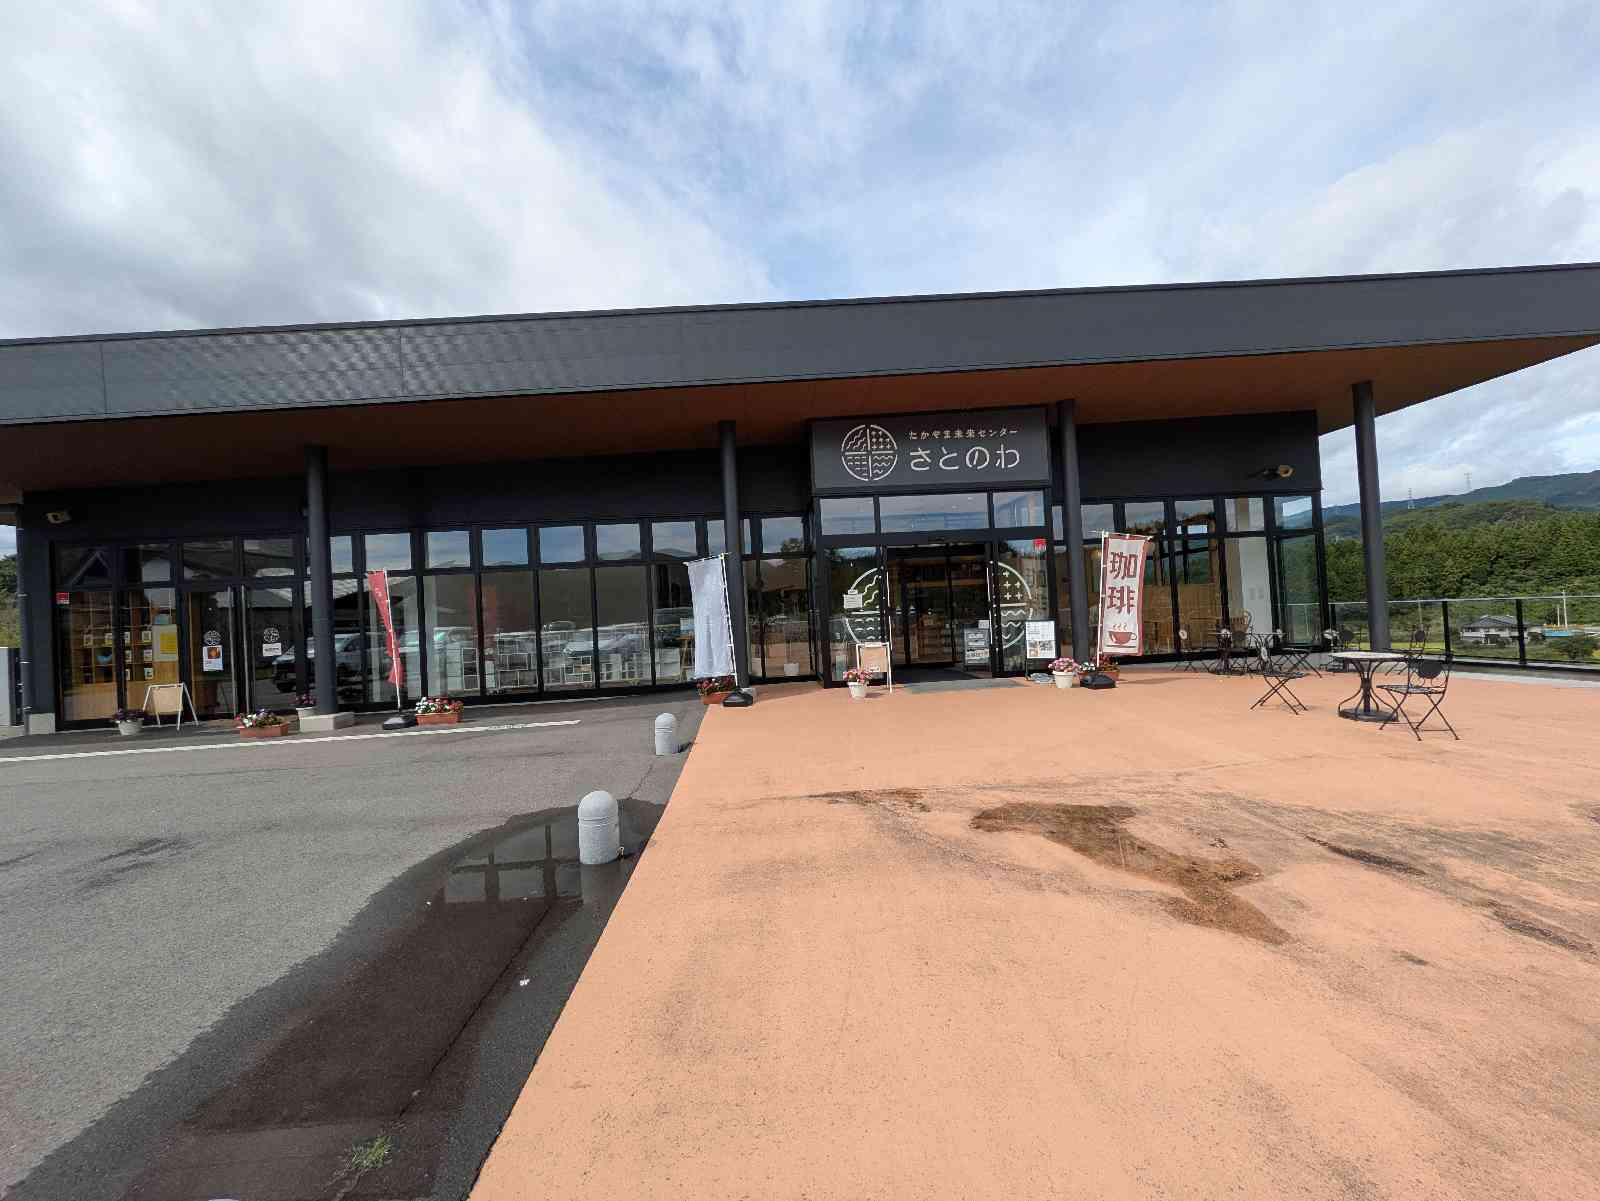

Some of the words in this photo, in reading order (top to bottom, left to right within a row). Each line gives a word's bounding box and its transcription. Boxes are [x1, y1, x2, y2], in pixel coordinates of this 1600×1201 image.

[909, 443, 1020, 471] さとのわ
[1107, 551, 1138, 615] 珈琲
